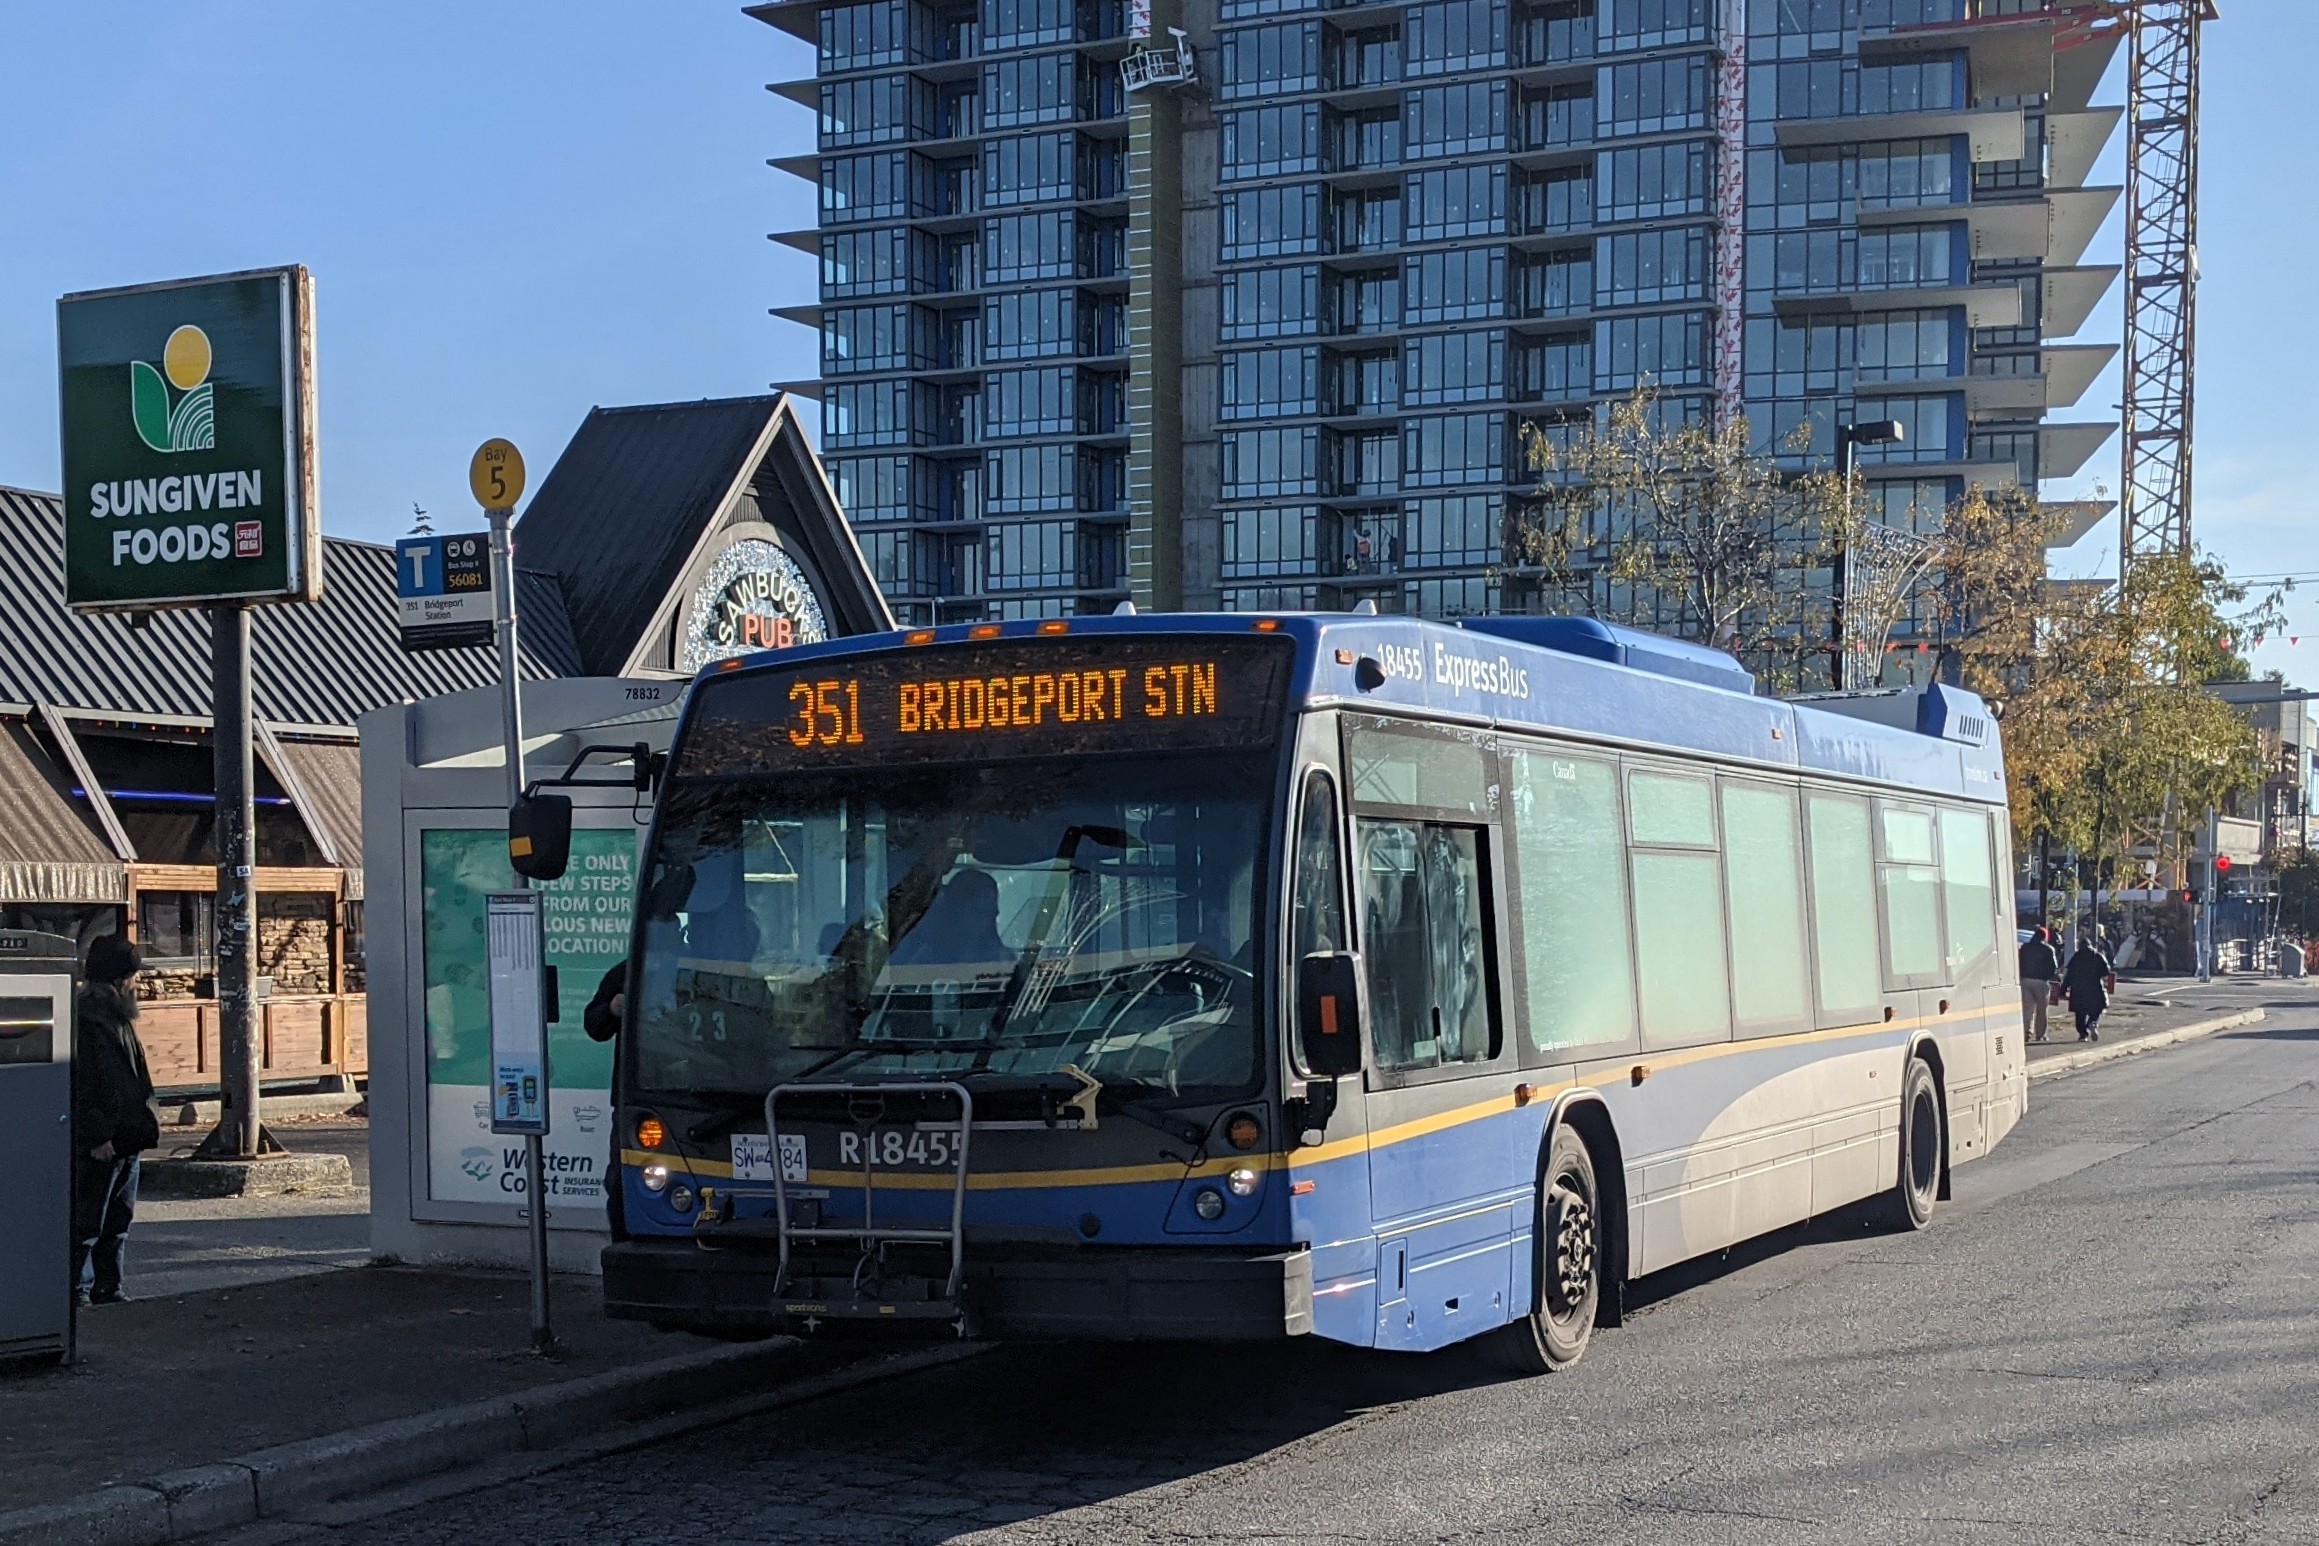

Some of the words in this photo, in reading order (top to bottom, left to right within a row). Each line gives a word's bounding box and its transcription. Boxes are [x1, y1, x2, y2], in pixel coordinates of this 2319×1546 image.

[485, 447, 507, 463] Bay
[491, 466, 506, 500] 5
[90, 469, 262, 518] SUNGIVEN
[112, 523, 231, 566] FOODS
[405, 546, 431, 588] T
[449, 573, 483, 588] 56081
[406, 601, 419, 611] 351
[425, 599, 463, 610] Bridgeport
[426, 611, 452, 620] Station
[745, 613, 794, 649] PUB
[1377, 643, 1422, 681] 18455
[625, 687, 660, 700] 78832
[789, 679, 864, 747] 351
[900, 669, 1126, 732] BRIDGEPORT
[1145, 662, 1216, 717] STN
[584, 855, 631, 871] ONLY
[580, 876, 632, 892] STEPS
[595, 896, 631, 912] OUR
[591, 917, 632, 933] NEW
[562, 1187, 600, 1196] SERVICES
